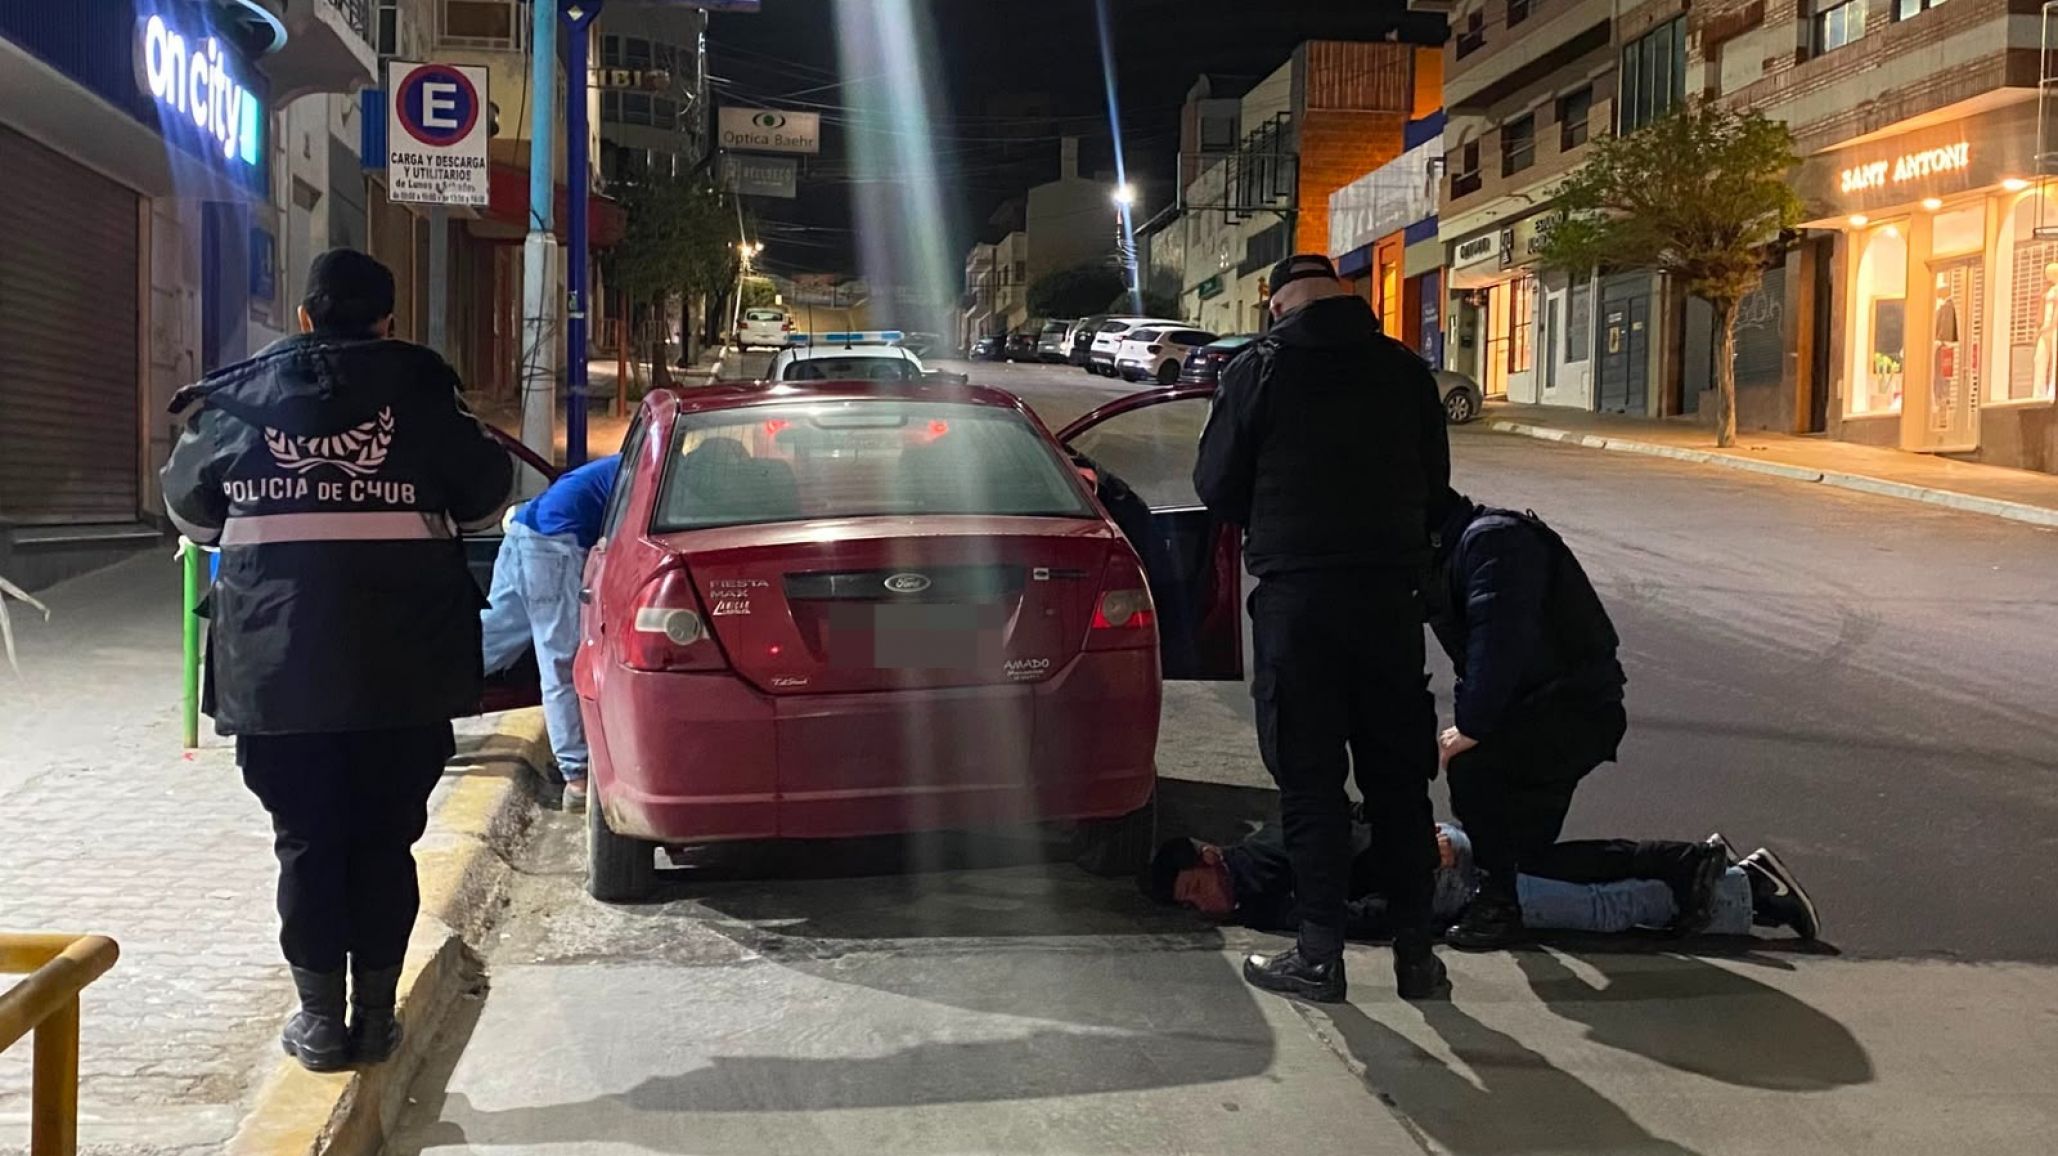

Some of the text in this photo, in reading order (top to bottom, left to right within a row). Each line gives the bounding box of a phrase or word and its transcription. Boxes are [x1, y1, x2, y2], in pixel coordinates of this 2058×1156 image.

[146, 15, 242, 159] on city
[422, 82, 457, 128] E
[774, 134, 815, 147] Baehr
[390, 152, 486, 169] CARGA Y DESCARGA
[1841, 142, 1970, 193] SANT ANTONI
[403, 166, 472, 181] Y UTILITARIOS
[395, 179, 406, 188] de
[317, 482, 344, 501] DE
[710, 579, 769, 588] FIESTA
[710, 590, 748, 599] MAX
[1003, 658, 1050, 670] AMADO
